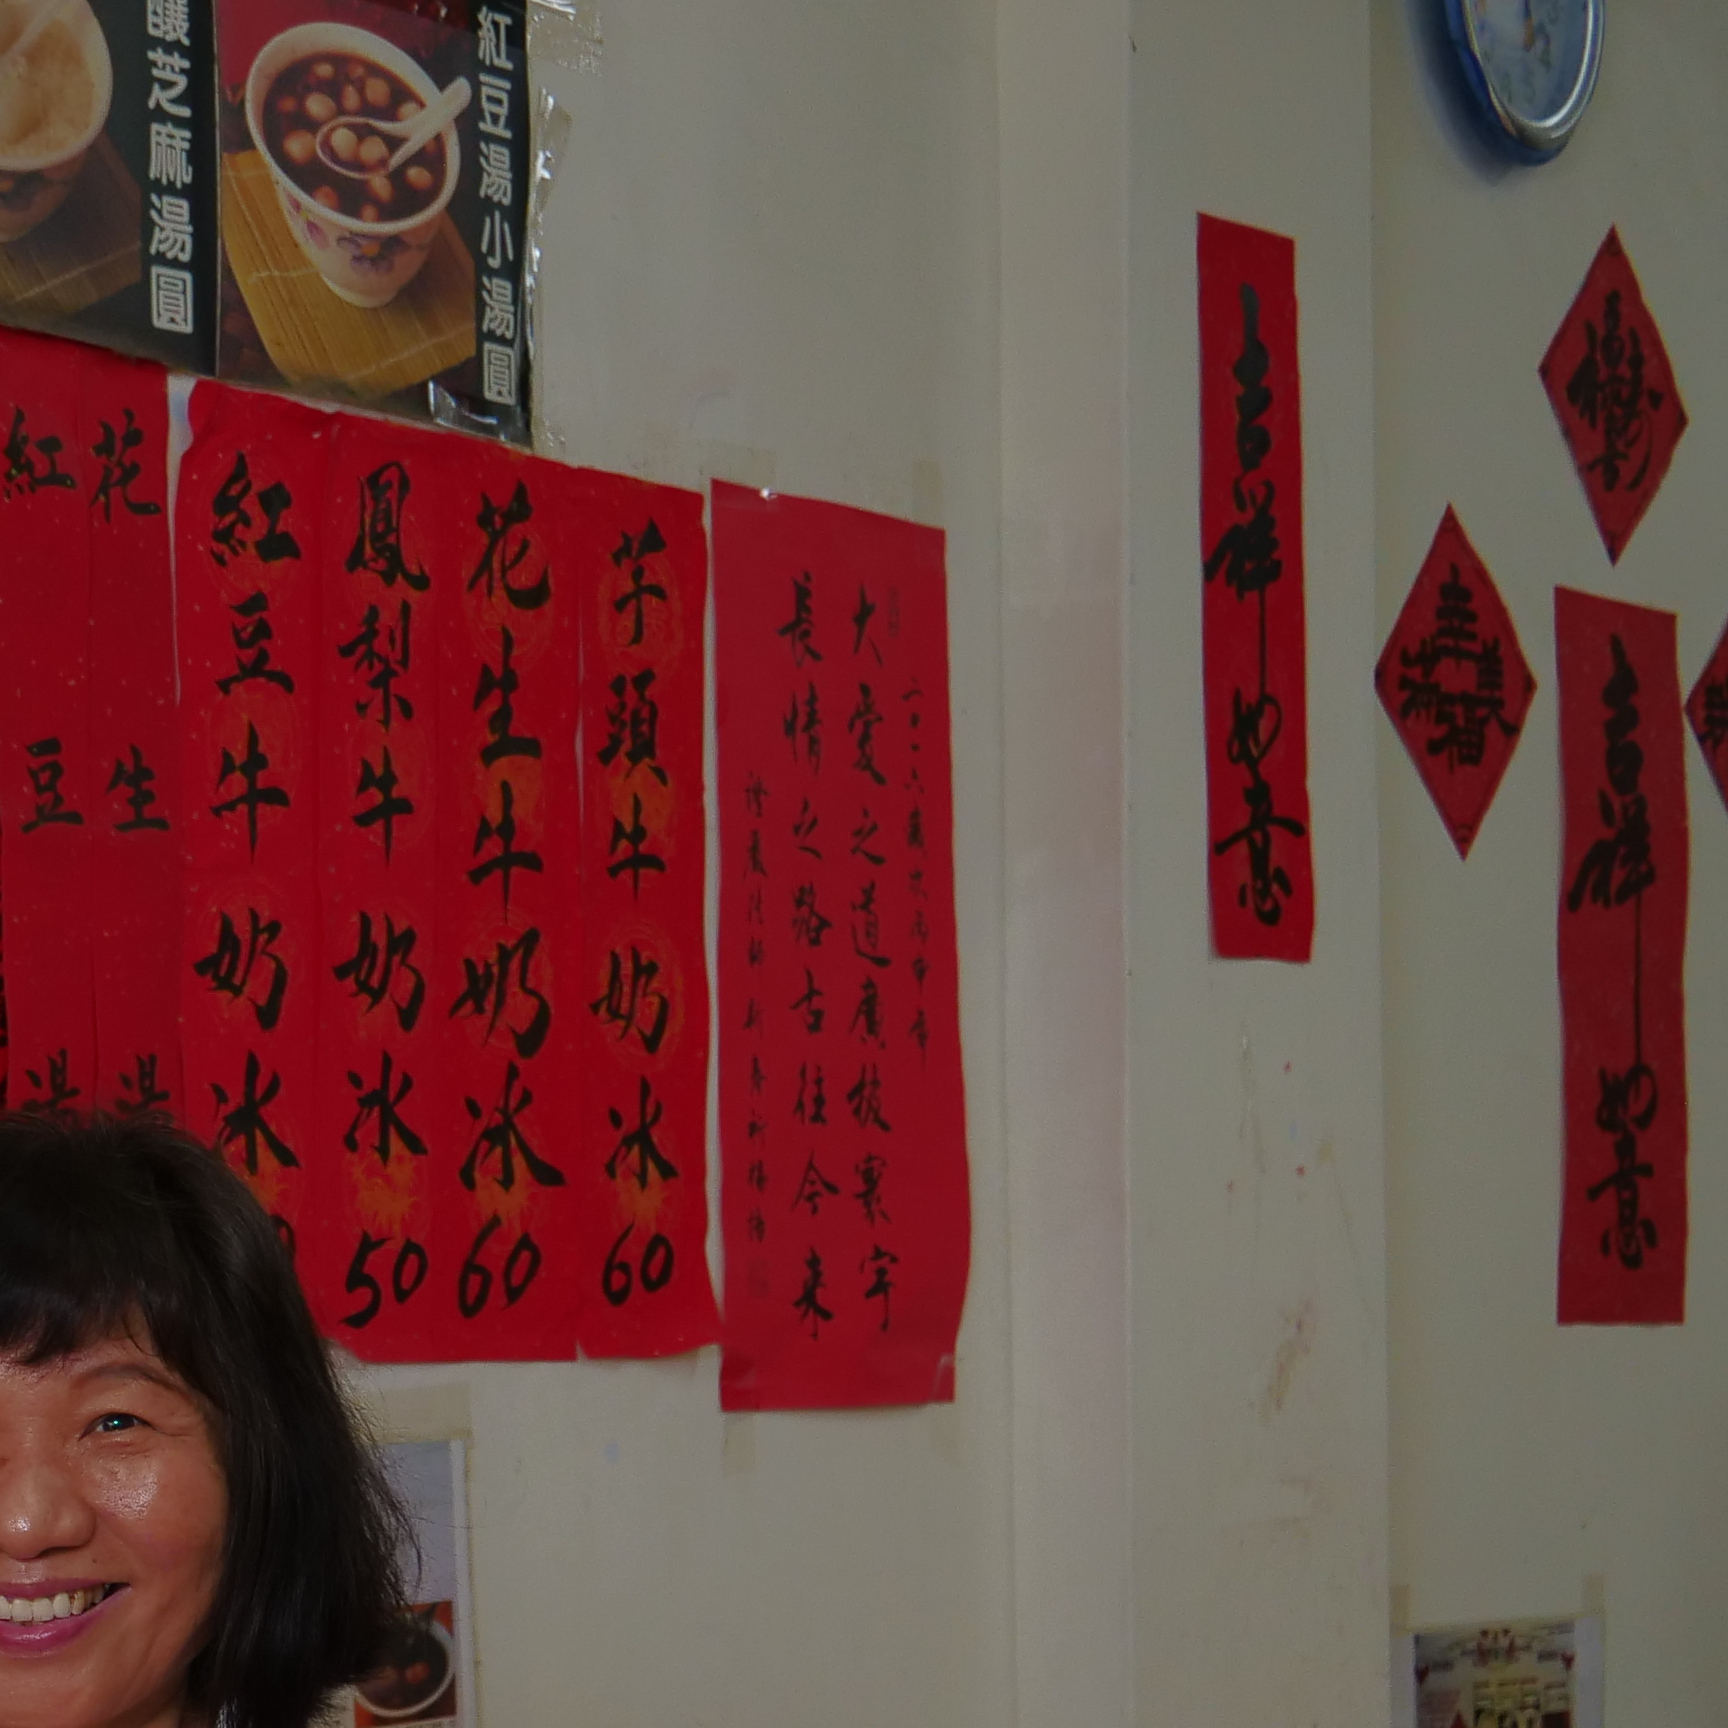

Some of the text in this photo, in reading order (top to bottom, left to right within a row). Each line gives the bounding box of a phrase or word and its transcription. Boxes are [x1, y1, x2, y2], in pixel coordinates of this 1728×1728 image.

[476, 7, 514, 405] 紅豆湯小湯圓
[194, 453, 301, 1176] 紅豆牛奶冰
[330, 463, 430, 1328] 鳳梨牛奶冰 50
[449, 483, 567, 1318] 花生牛奶冰 60
[584, 515, 682, 1309] 芋頭牛奶冰 60
